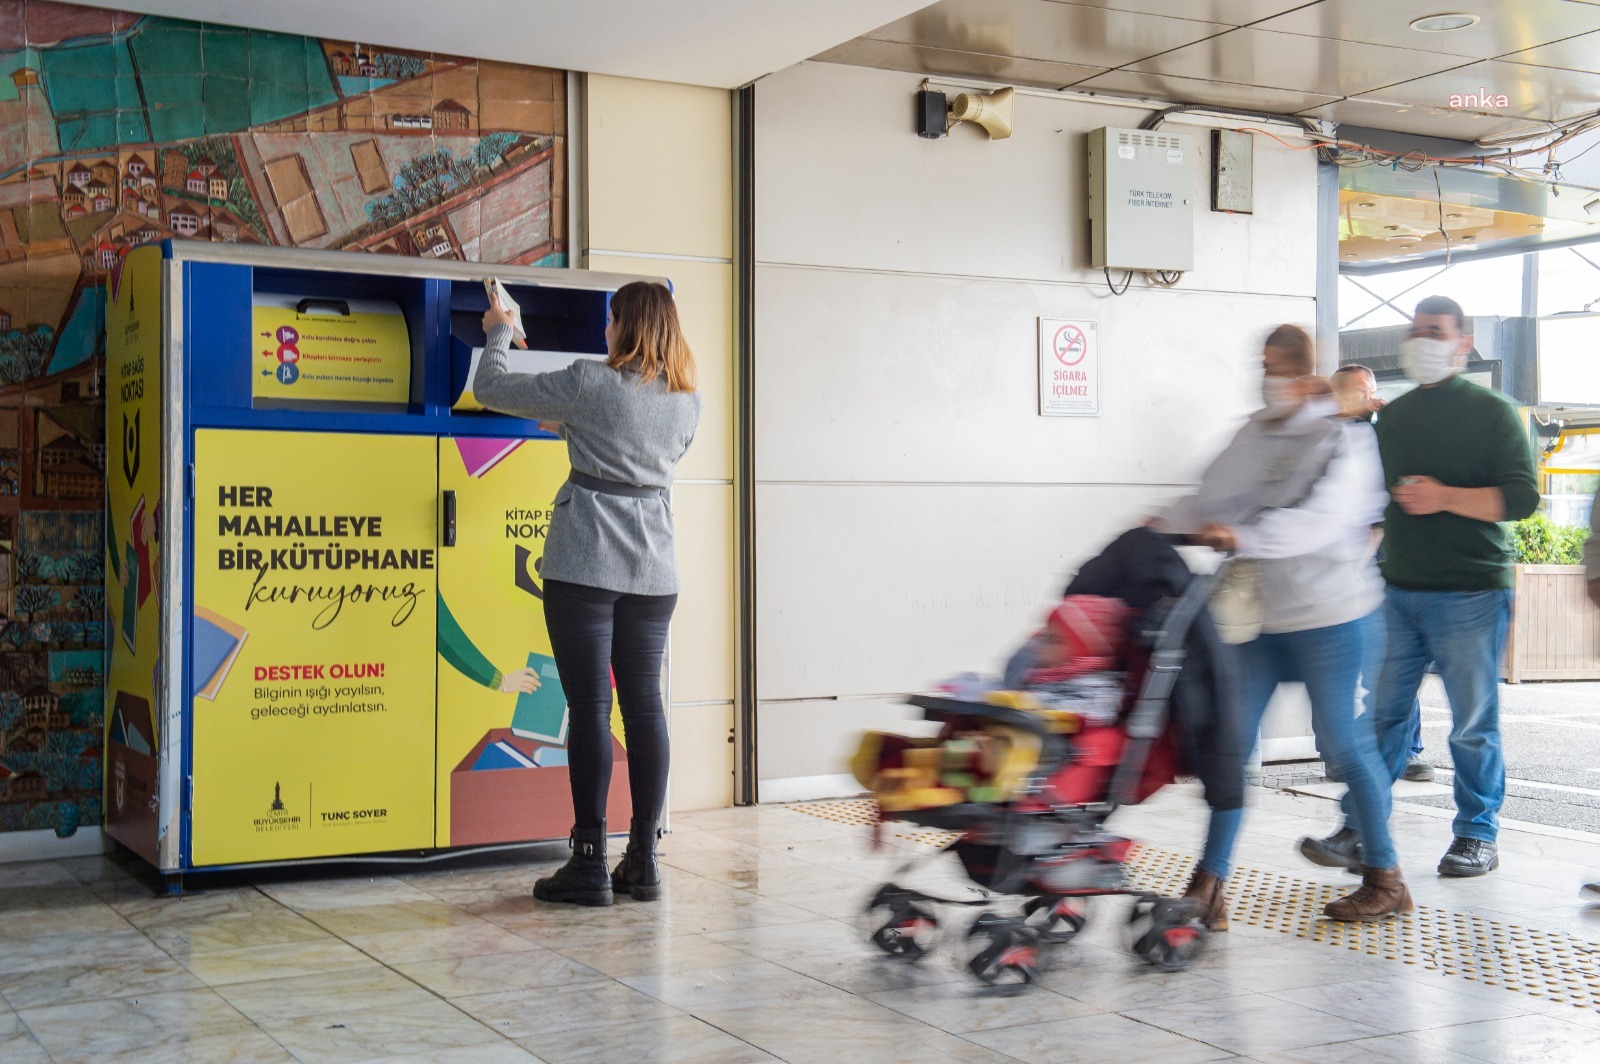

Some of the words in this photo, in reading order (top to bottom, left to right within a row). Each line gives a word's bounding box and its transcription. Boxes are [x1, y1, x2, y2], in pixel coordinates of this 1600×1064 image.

[1129, 189, 1144, 197] TÜRK
[1146, 191, 1172, 199] TELEKOM
[1146, 199, 1173, 208] İNTERNET
[1053, 368, 1087, 381] SİGARA
[120, 378, 144, 404] NOKTASI
[1052, 383, 1088, 398] İÇİLMEZ
[218, 485, 273, 507] HER
[505, 507, 543, 521] KİTAP
[218, 515, 382, 537] MAHALLEYE
[218, 542, 264, 570] BİR
[270, 542, 434, 570] KÜTÜPHANE
[245, 562, 426, 630] kuruyoruz
[254, 665, 325, 681] DESTEK
[329, 663, 385, 679] OLUN!
[254, 686, 302, 701] Bilginin
[305, 685, 331, 701] ışığı
[334, 684, 385, 699] yayılsın,
[250, 703, 309, 720] geleceği
[313, 702, 387, 716] aydınlatsın.
[321, 811, 351, 821] TUNÇ
[353, 808, 387, 819] SOYER
